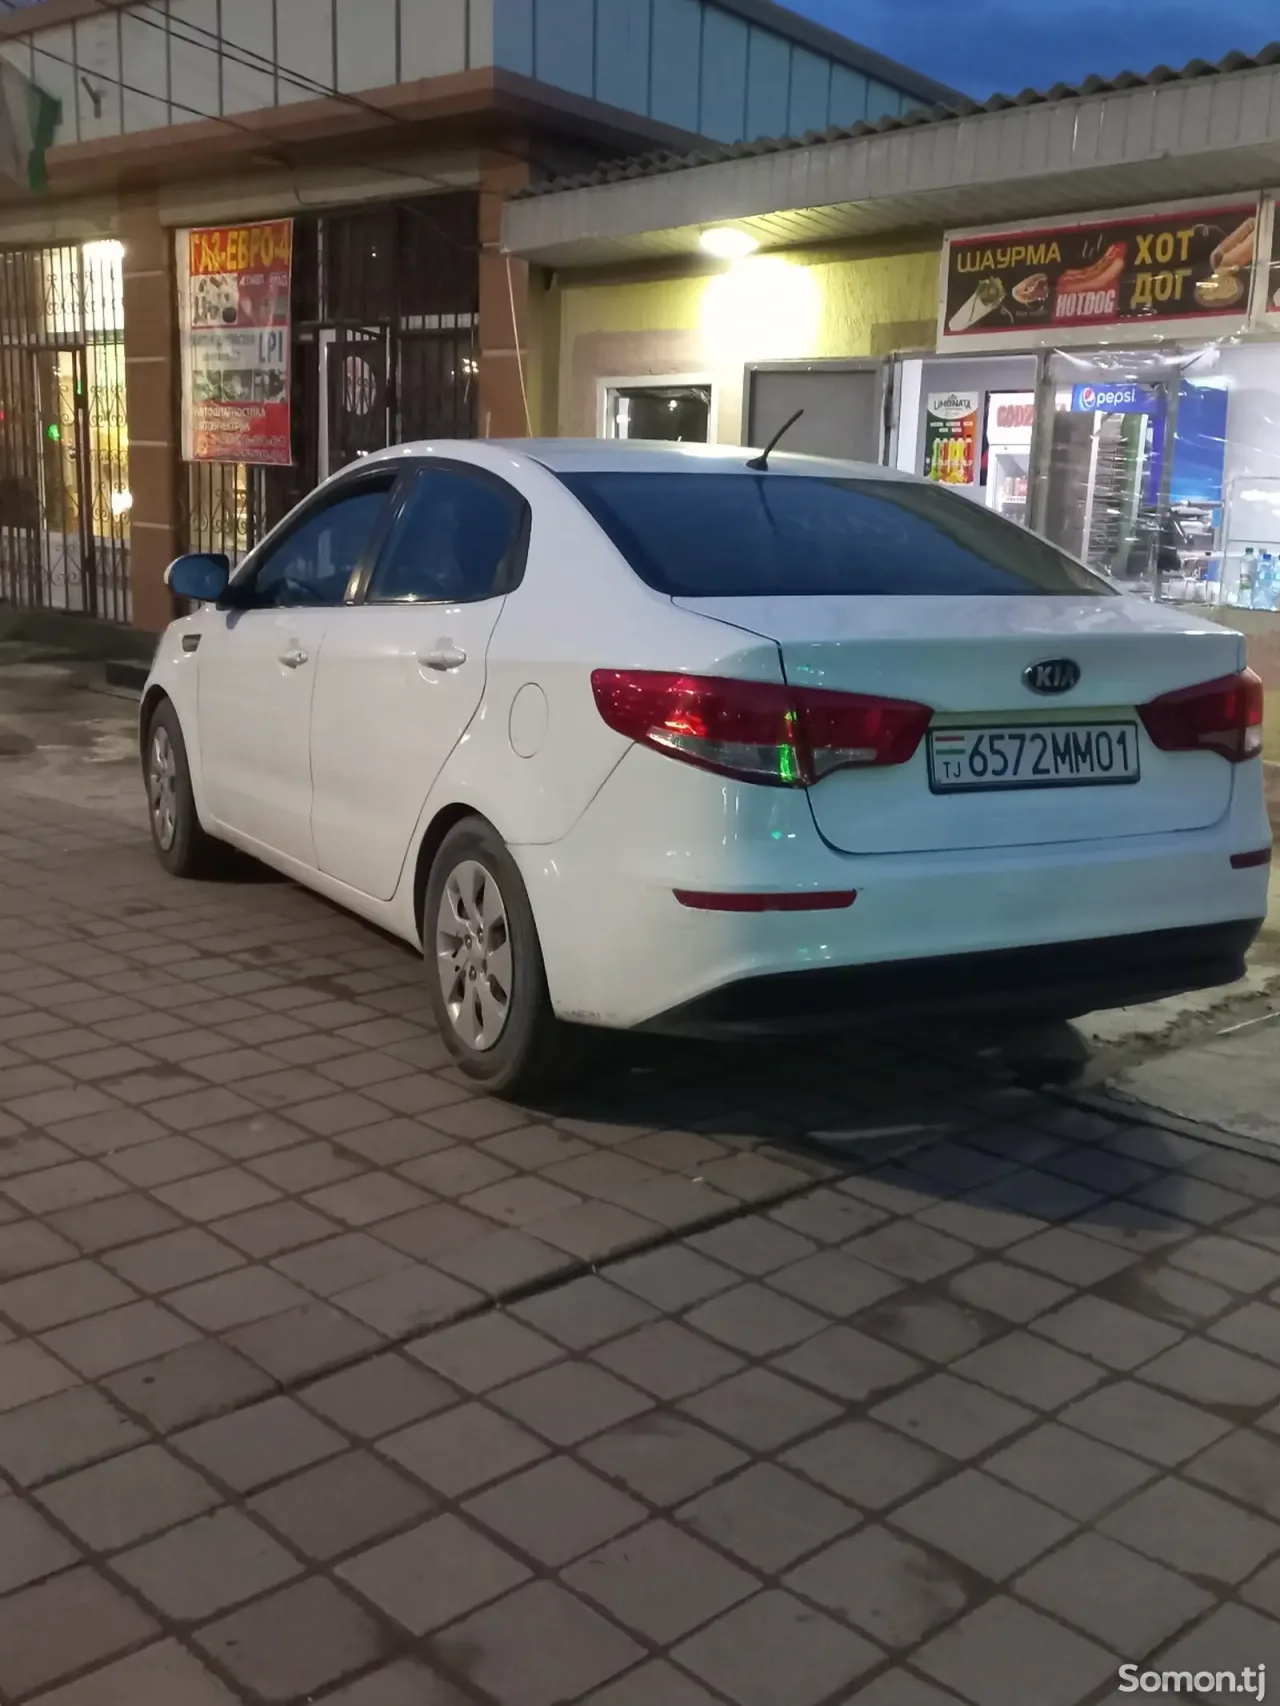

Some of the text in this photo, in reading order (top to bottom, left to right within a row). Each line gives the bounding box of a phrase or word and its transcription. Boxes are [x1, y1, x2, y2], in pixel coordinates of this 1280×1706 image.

[957, 242, 1061, 273] ШАУРМА
[1134, 229, 1195, 266] ХОТ
[1055, 289, 1116, 317] HOTDOG
[1130, 267, 1193, 309] ДОГ
[1096, 388, 1136, 407] pepsi
[1035, 664, 1077, 688] KIA
[943, 730, 1129, 779] TJ 6572MM01
